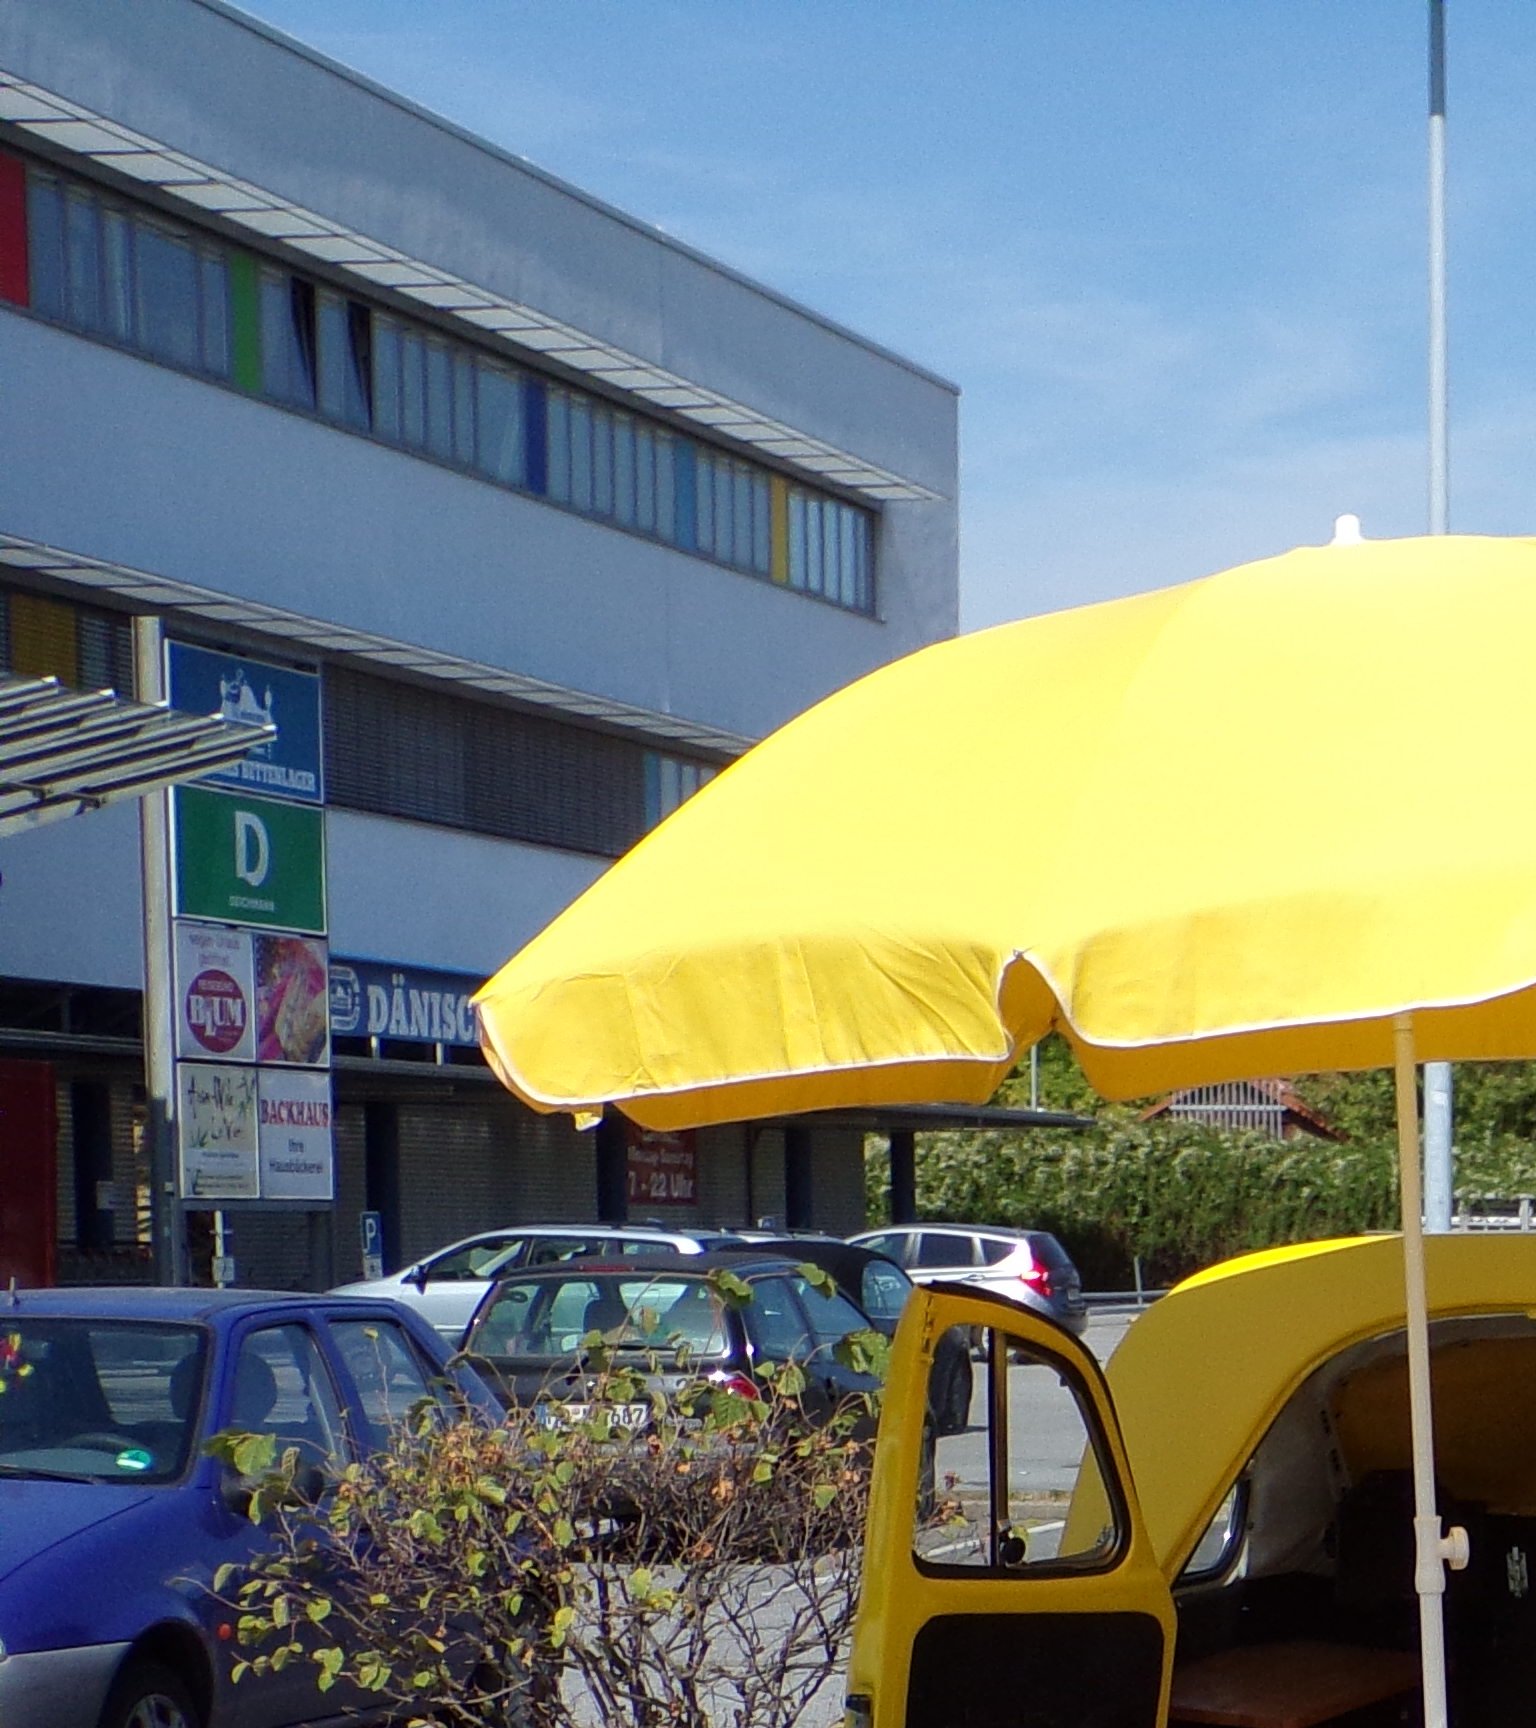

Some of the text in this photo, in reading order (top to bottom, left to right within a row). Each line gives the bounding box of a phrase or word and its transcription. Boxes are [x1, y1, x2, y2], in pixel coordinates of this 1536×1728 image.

[234, 810, 270, 887] D
[261, 1099, 330, 1128] BACKHAUS
[366, 1218, 377, 1251] P
